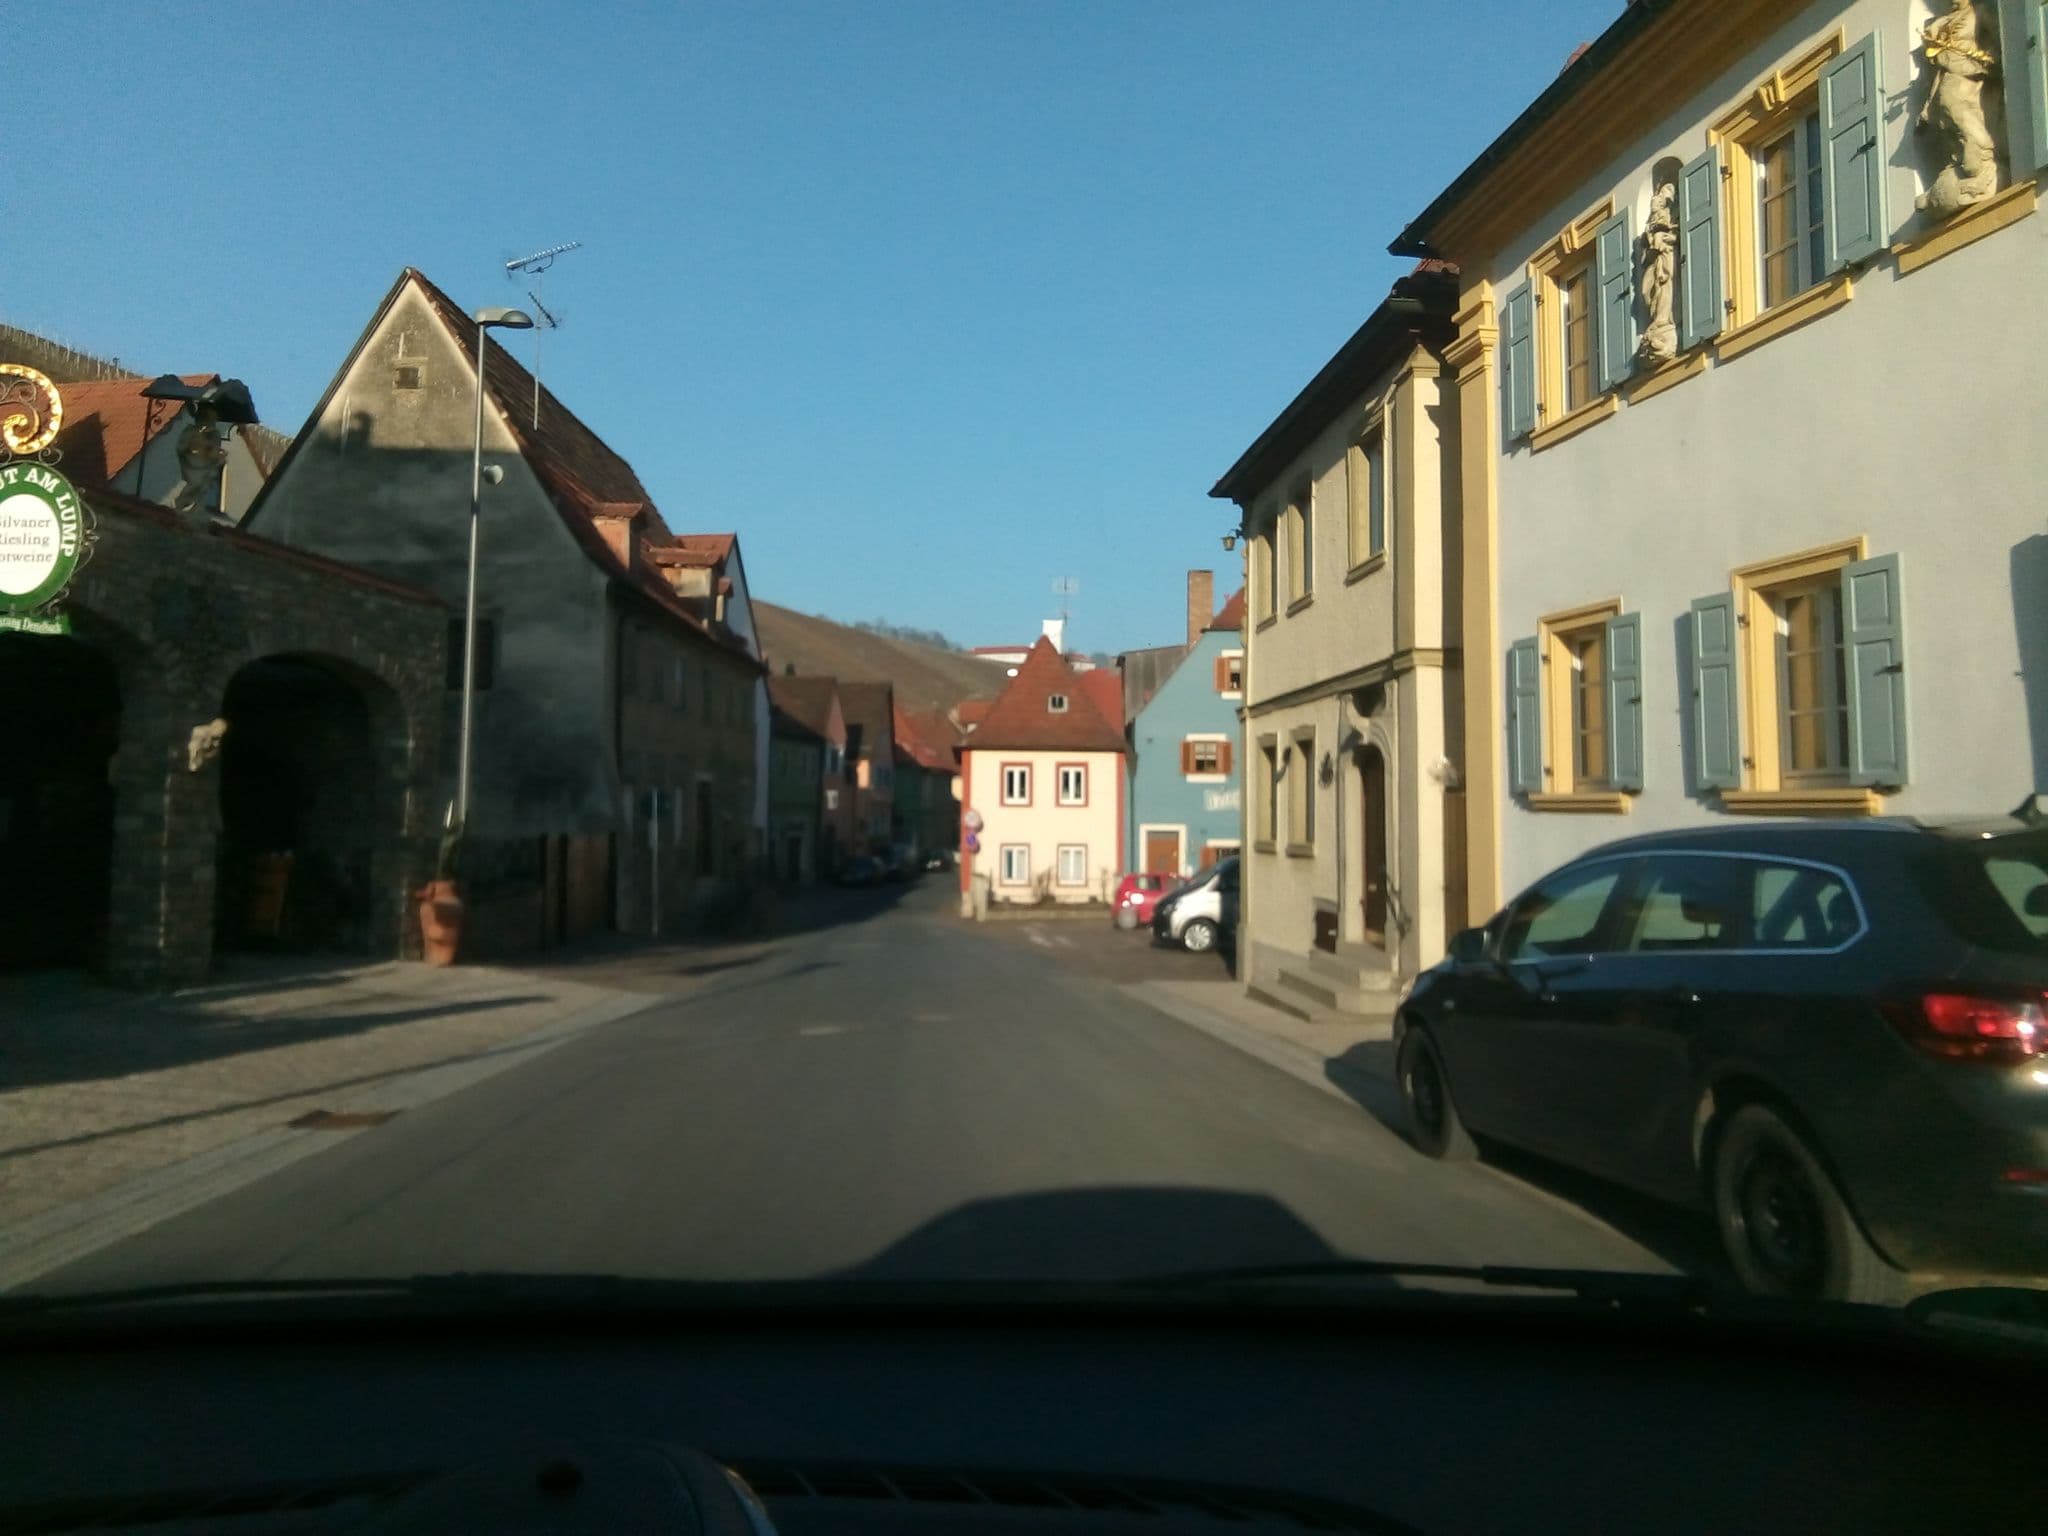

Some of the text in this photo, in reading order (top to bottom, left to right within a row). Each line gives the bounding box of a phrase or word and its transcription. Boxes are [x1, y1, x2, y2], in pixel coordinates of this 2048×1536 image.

[0, 515, 51, 528] ilvaner
[23, 467, 60, 493] AM
[56, 492, 77, 557] LUMP
